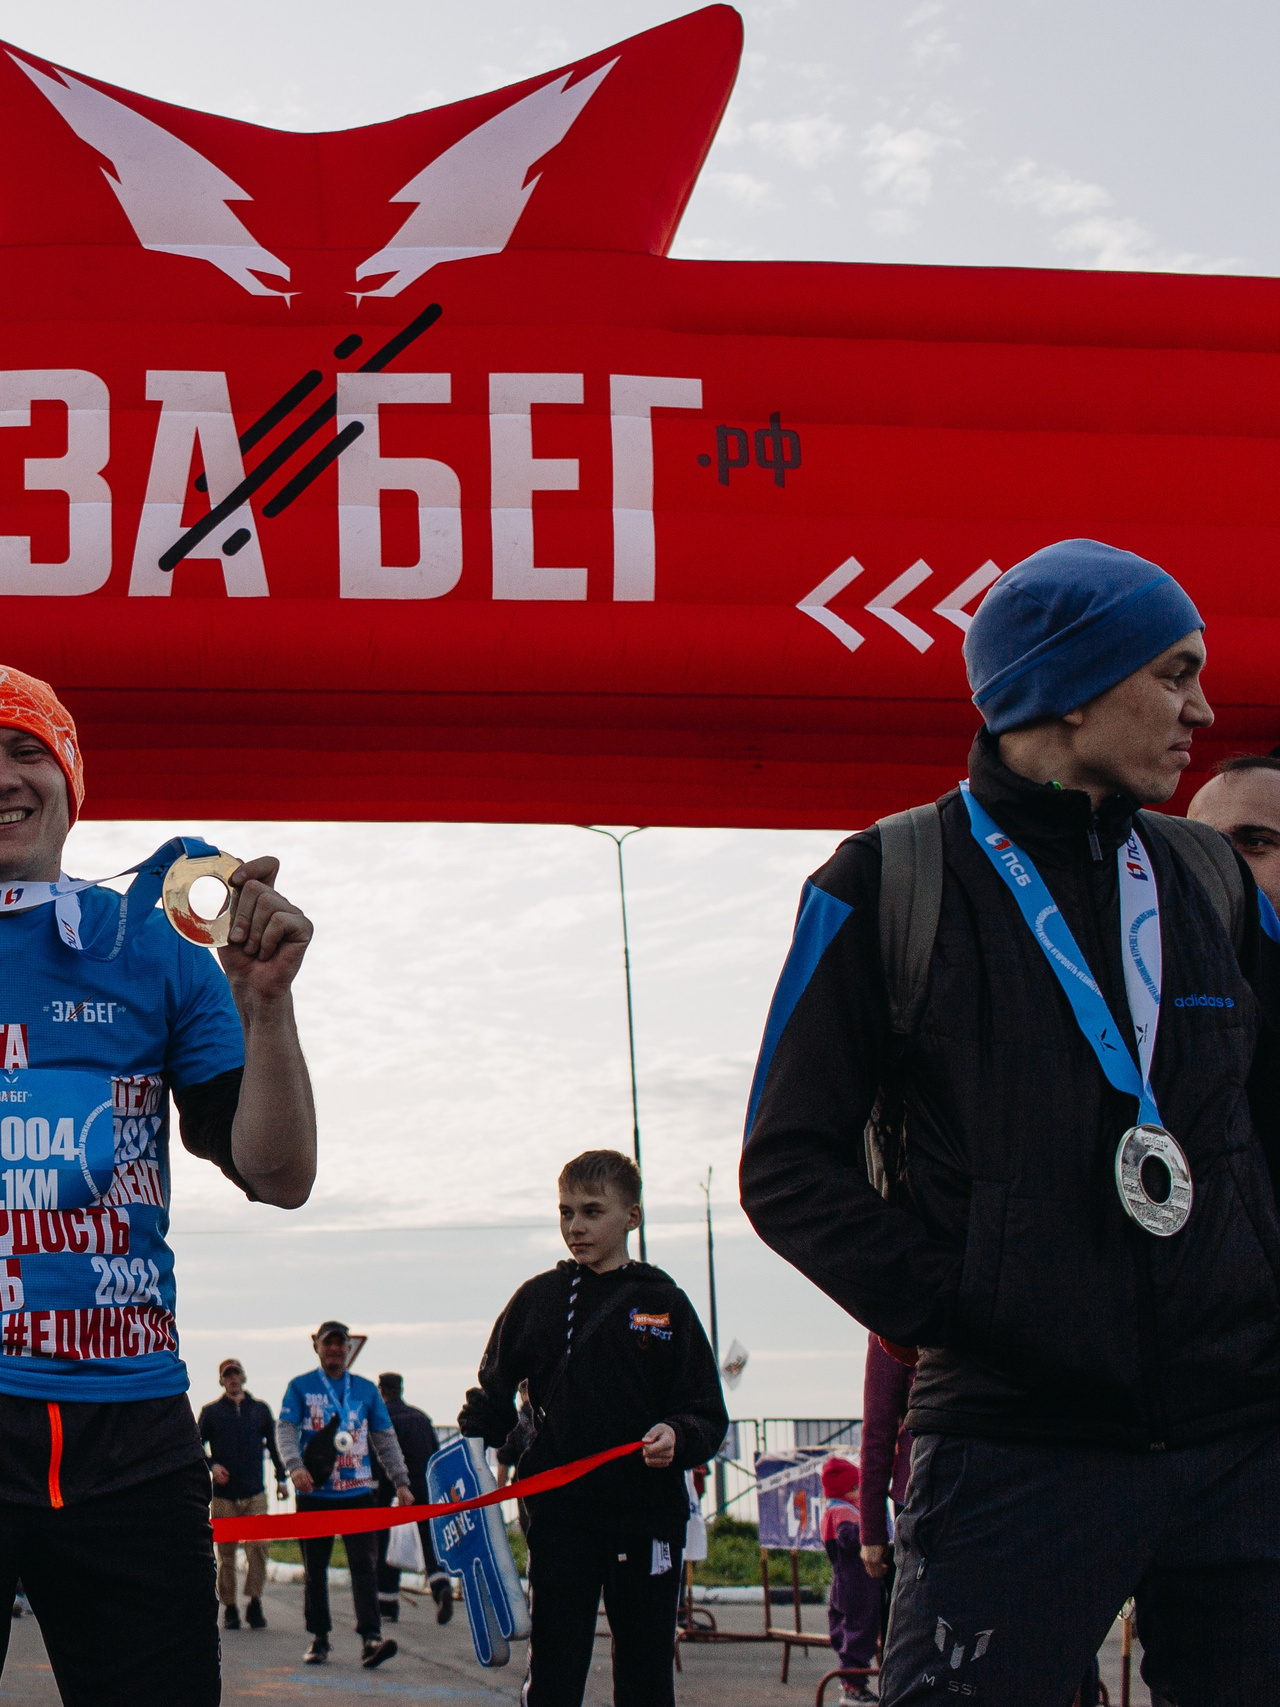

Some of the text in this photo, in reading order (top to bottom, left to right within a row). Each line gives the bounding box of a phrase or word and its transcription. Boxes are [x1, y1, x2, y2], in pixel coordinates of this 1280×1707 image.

[1001, 851, 1032, 886] ПСБ
[1174, 993, 1224, 1007] adidas
[90, 1256, 162, 1306] 2024
